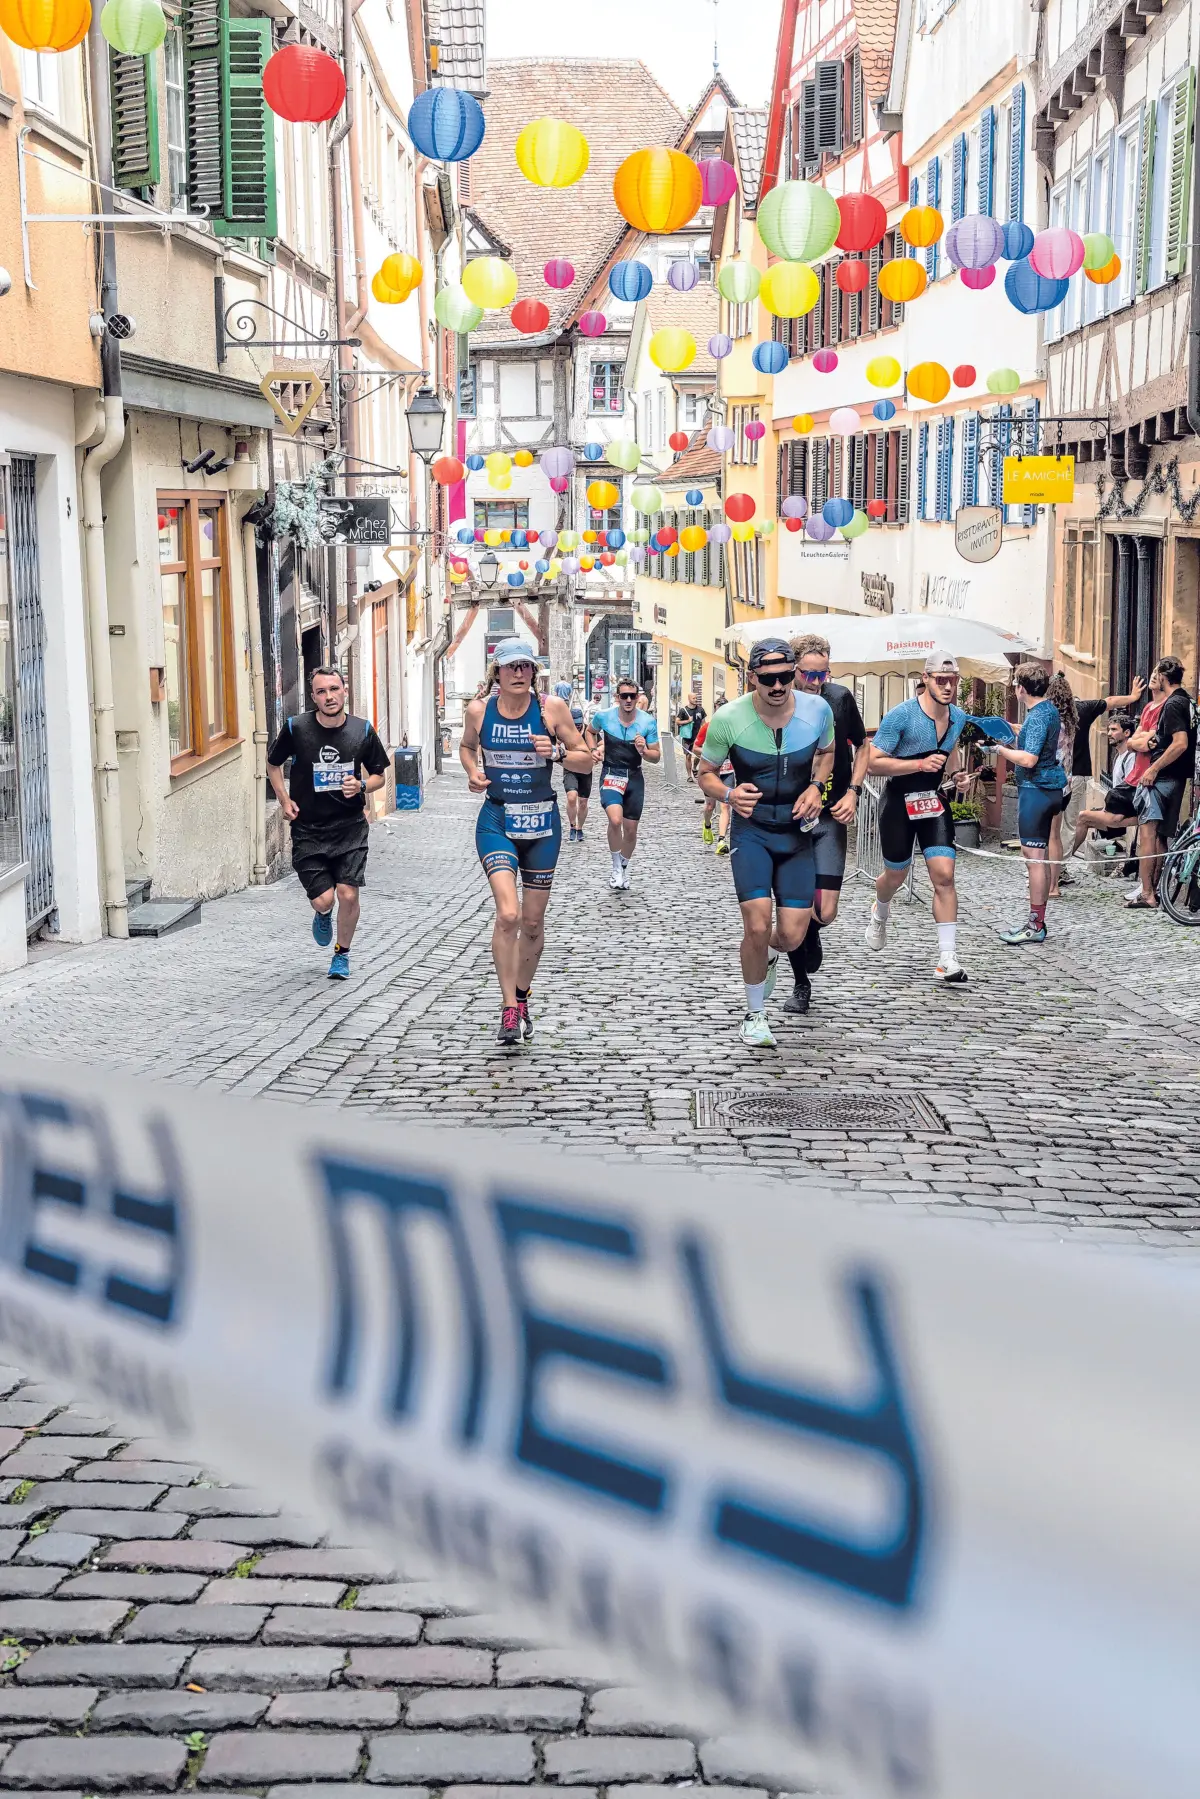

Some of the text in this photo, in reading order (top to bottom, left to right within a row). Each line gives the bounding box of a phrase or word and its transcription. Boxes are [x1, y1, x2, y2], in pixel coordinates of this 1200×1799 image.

[356, 517, 386, 529] Chez
[957, 512, 1000, 543] RISTORANTE
[349, 528, 388, 540] Michel
[970, 529, 999, 551] INVITTO
[886, 640, 936, 651] Baisinger
[491, 723, 532, 738] MEY
[913, 799, 939, 811] 1339
[512, 814, 546, 829] 3261
[312, 1152, 922, 1608] MEY
